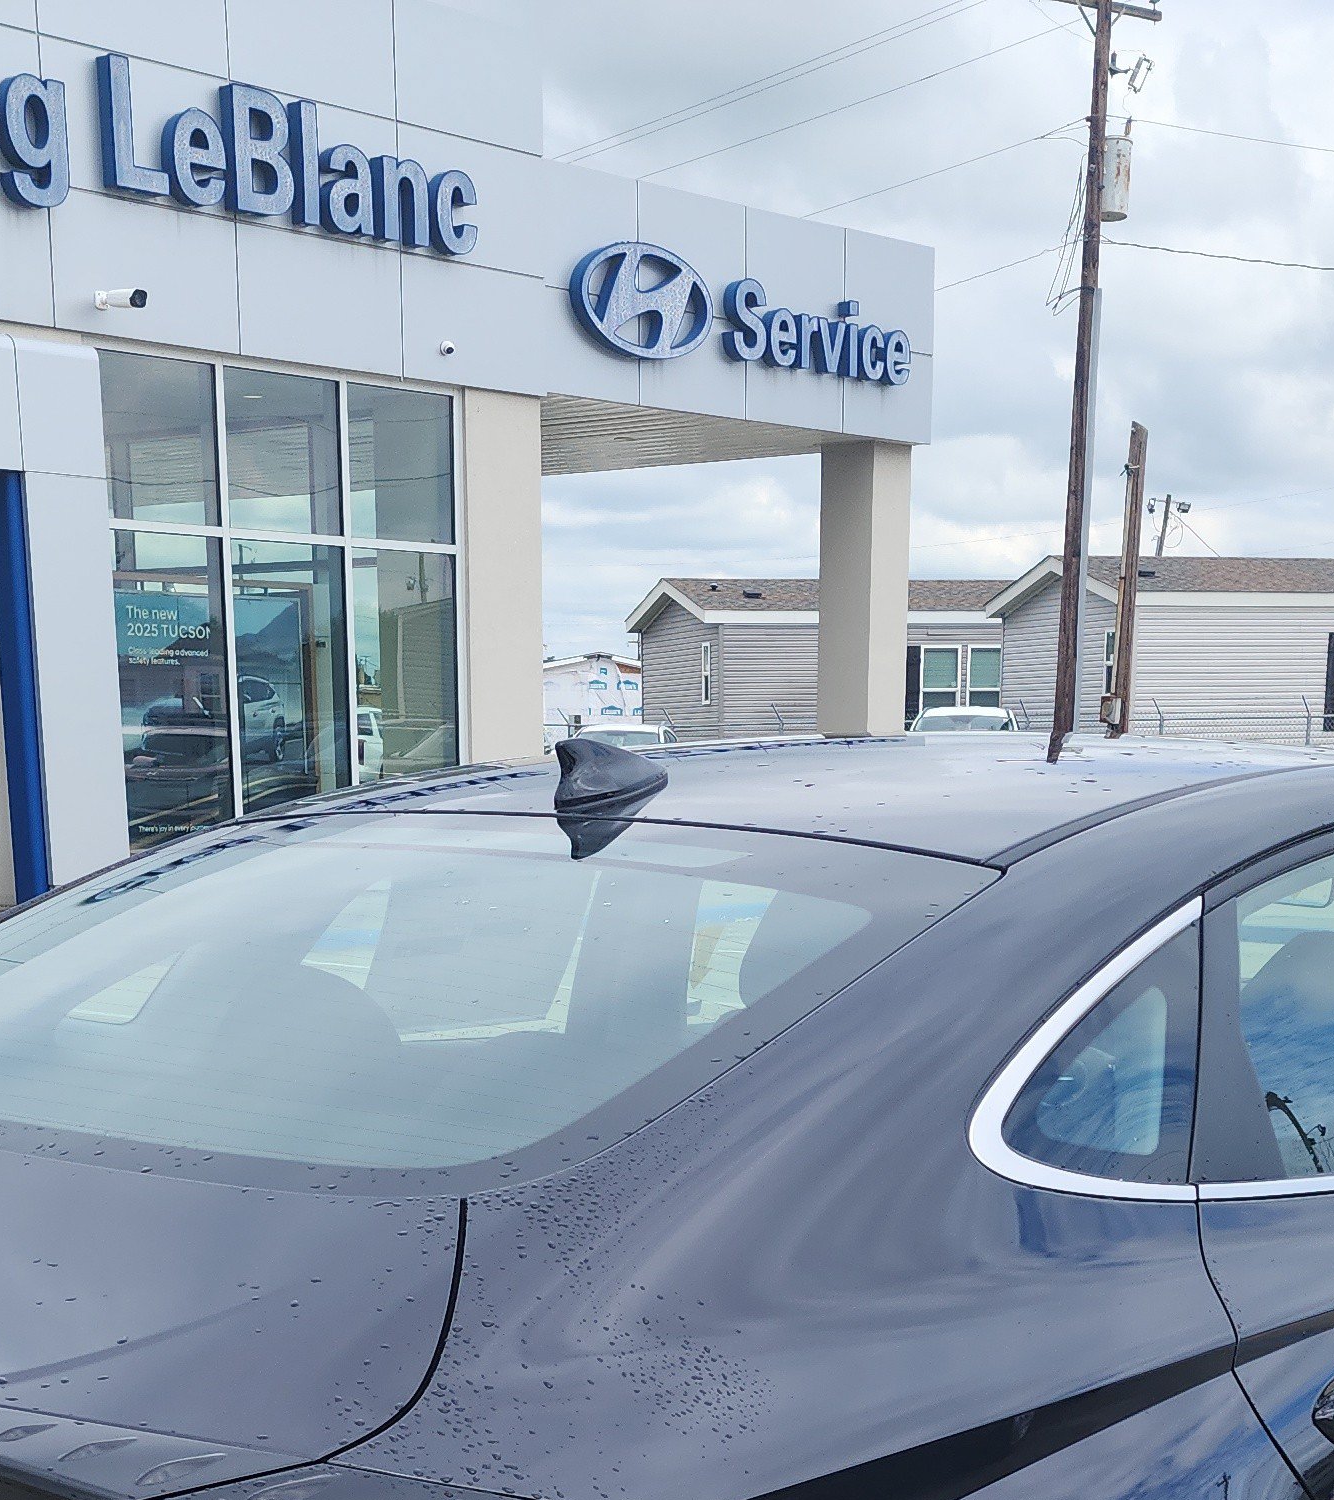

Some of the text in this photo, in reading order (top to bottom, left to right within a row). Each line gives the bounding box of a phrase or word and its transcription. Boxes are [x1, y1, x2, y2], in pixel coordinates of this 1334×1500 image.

[96, 53, 478, 256] LeBlanc
[721, 278, 911, 386] Service
[127, 605, 178, 621] The new
[127, 622, 159, 638] 2025
[174, 648, 209, 657] advanced
